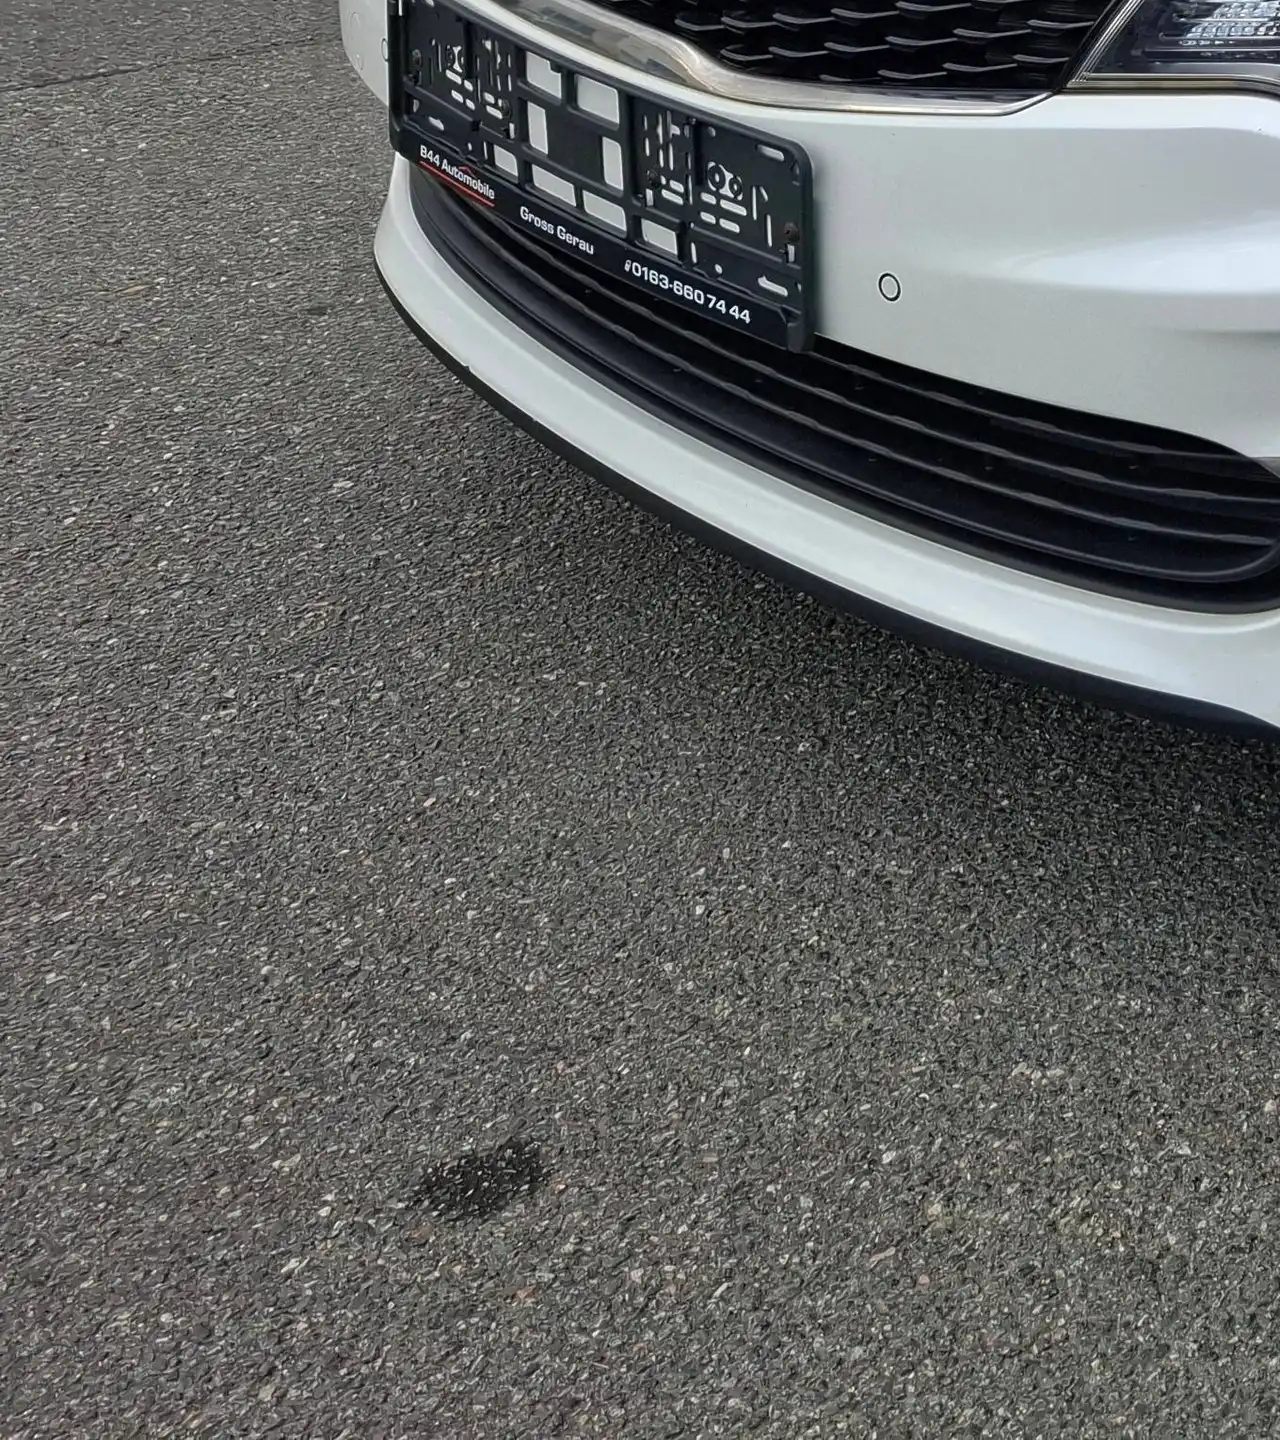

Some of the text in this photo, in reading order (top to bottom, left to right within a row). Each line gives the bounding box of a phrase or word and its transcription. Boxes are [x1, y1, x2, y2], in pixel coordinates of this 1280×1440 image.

[420, 144, 495, 200] B44 Automobile
[519, 206, 595, 255] Gross Gerau
